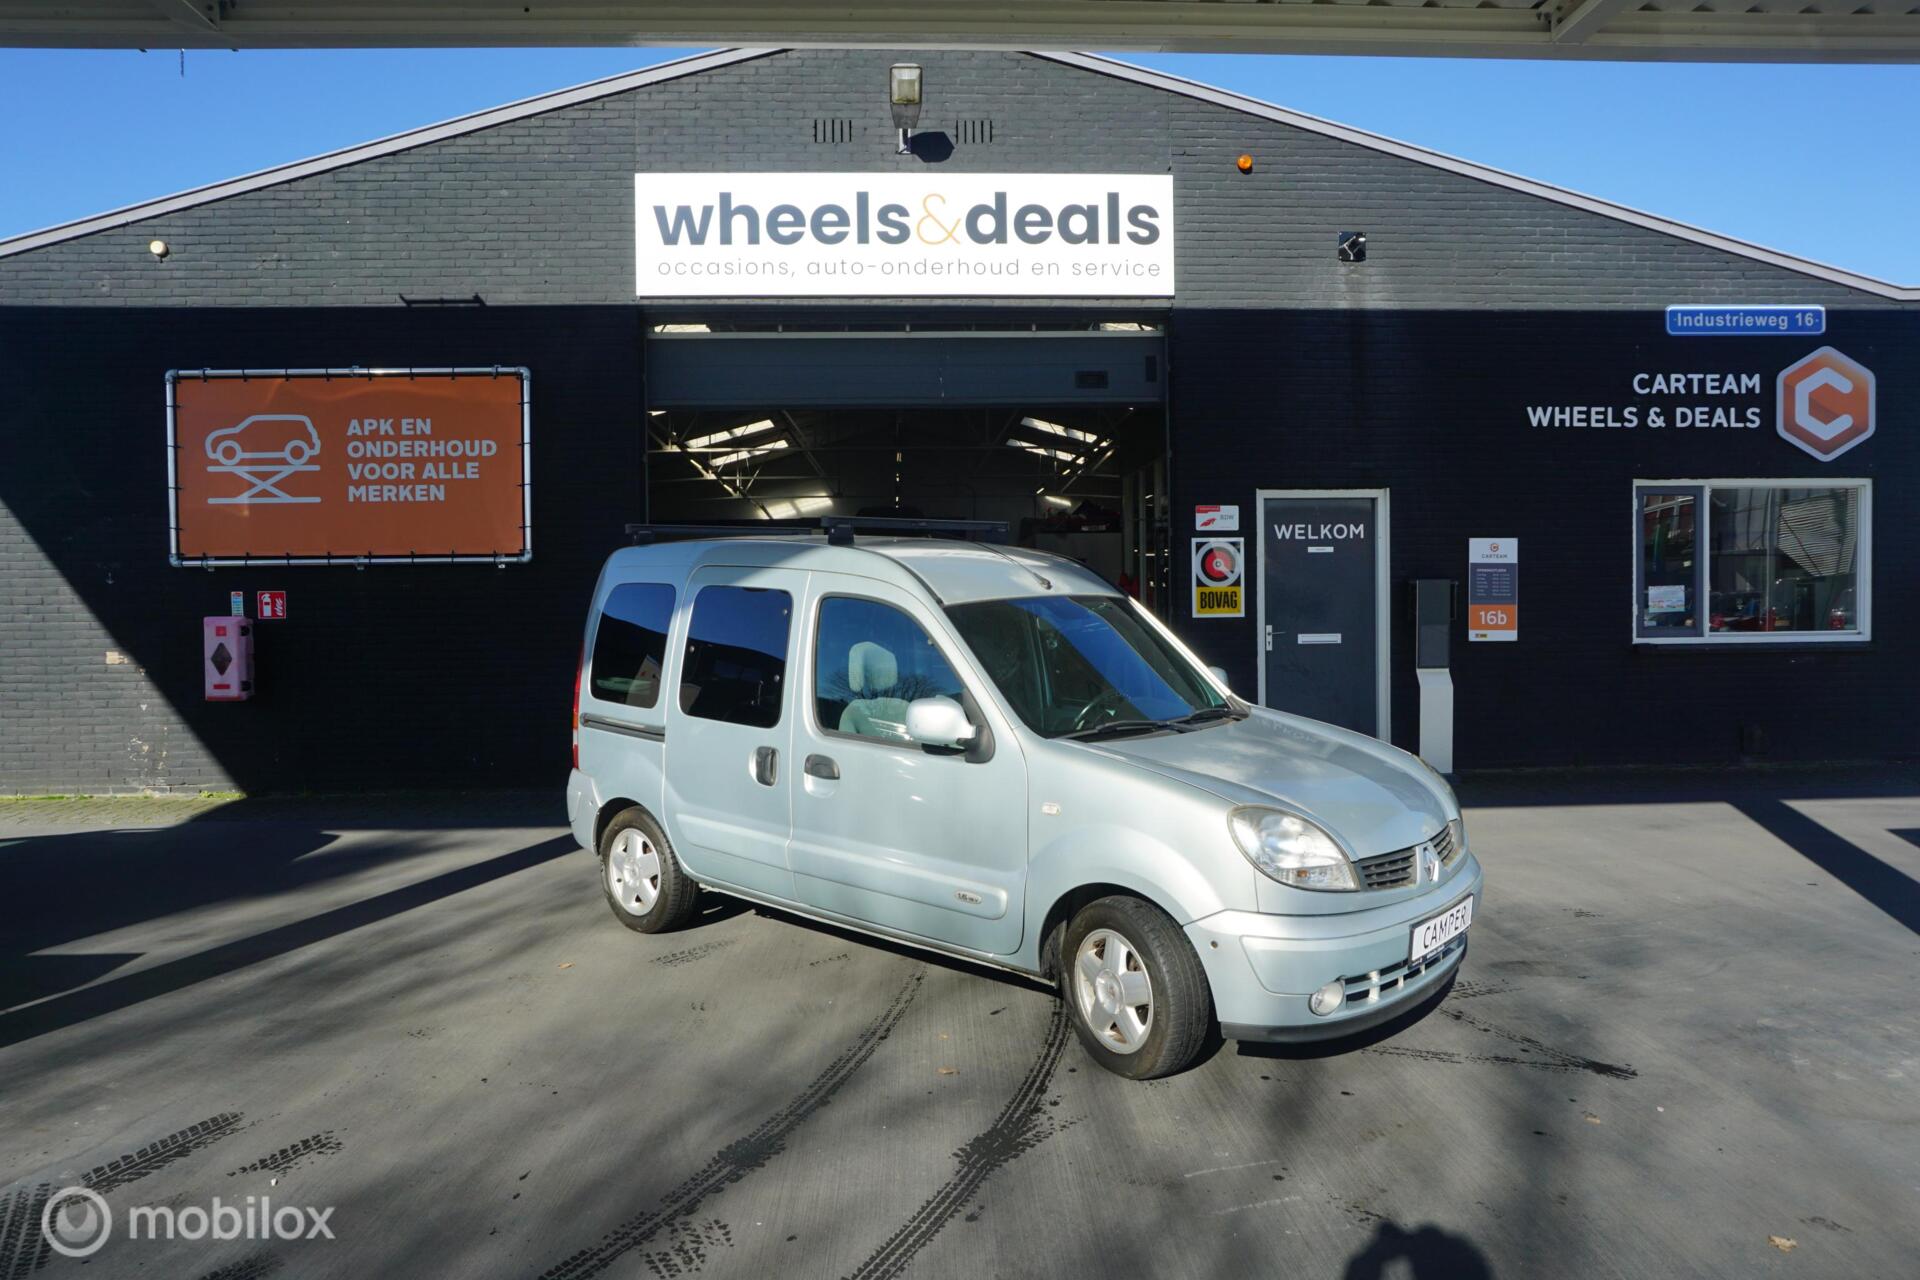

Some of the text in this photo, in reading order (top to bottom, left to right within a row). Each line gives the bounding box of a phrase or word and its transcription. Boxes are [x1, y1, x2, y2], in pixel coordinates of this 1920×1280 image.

[654, 191, 1160, 245] wheels&deals
[658, 258, 1161, 278] occasions, auto-onderhoud en service
[1677, 312, 1814, 330] Industrieweg 16
[1633, 373, 1760, 394] CARTEAM
[1527, 406, 1761, 428] WHEELS & DEALS
[347, 418, 431, 436] APK EN
[347, 439, 497, 458] ONDERHOUD
[347, 462, 479, 480] VOOR ALLE
[348, 484, 446, 502] MERKEN
[1273, 523, 1364, 540] WELKOM
[1200, 590, 1238, 609] BOVAG
[1479, 610, 1507, 625] 16b
[1423, 905, 1467, 949] CAMPER
